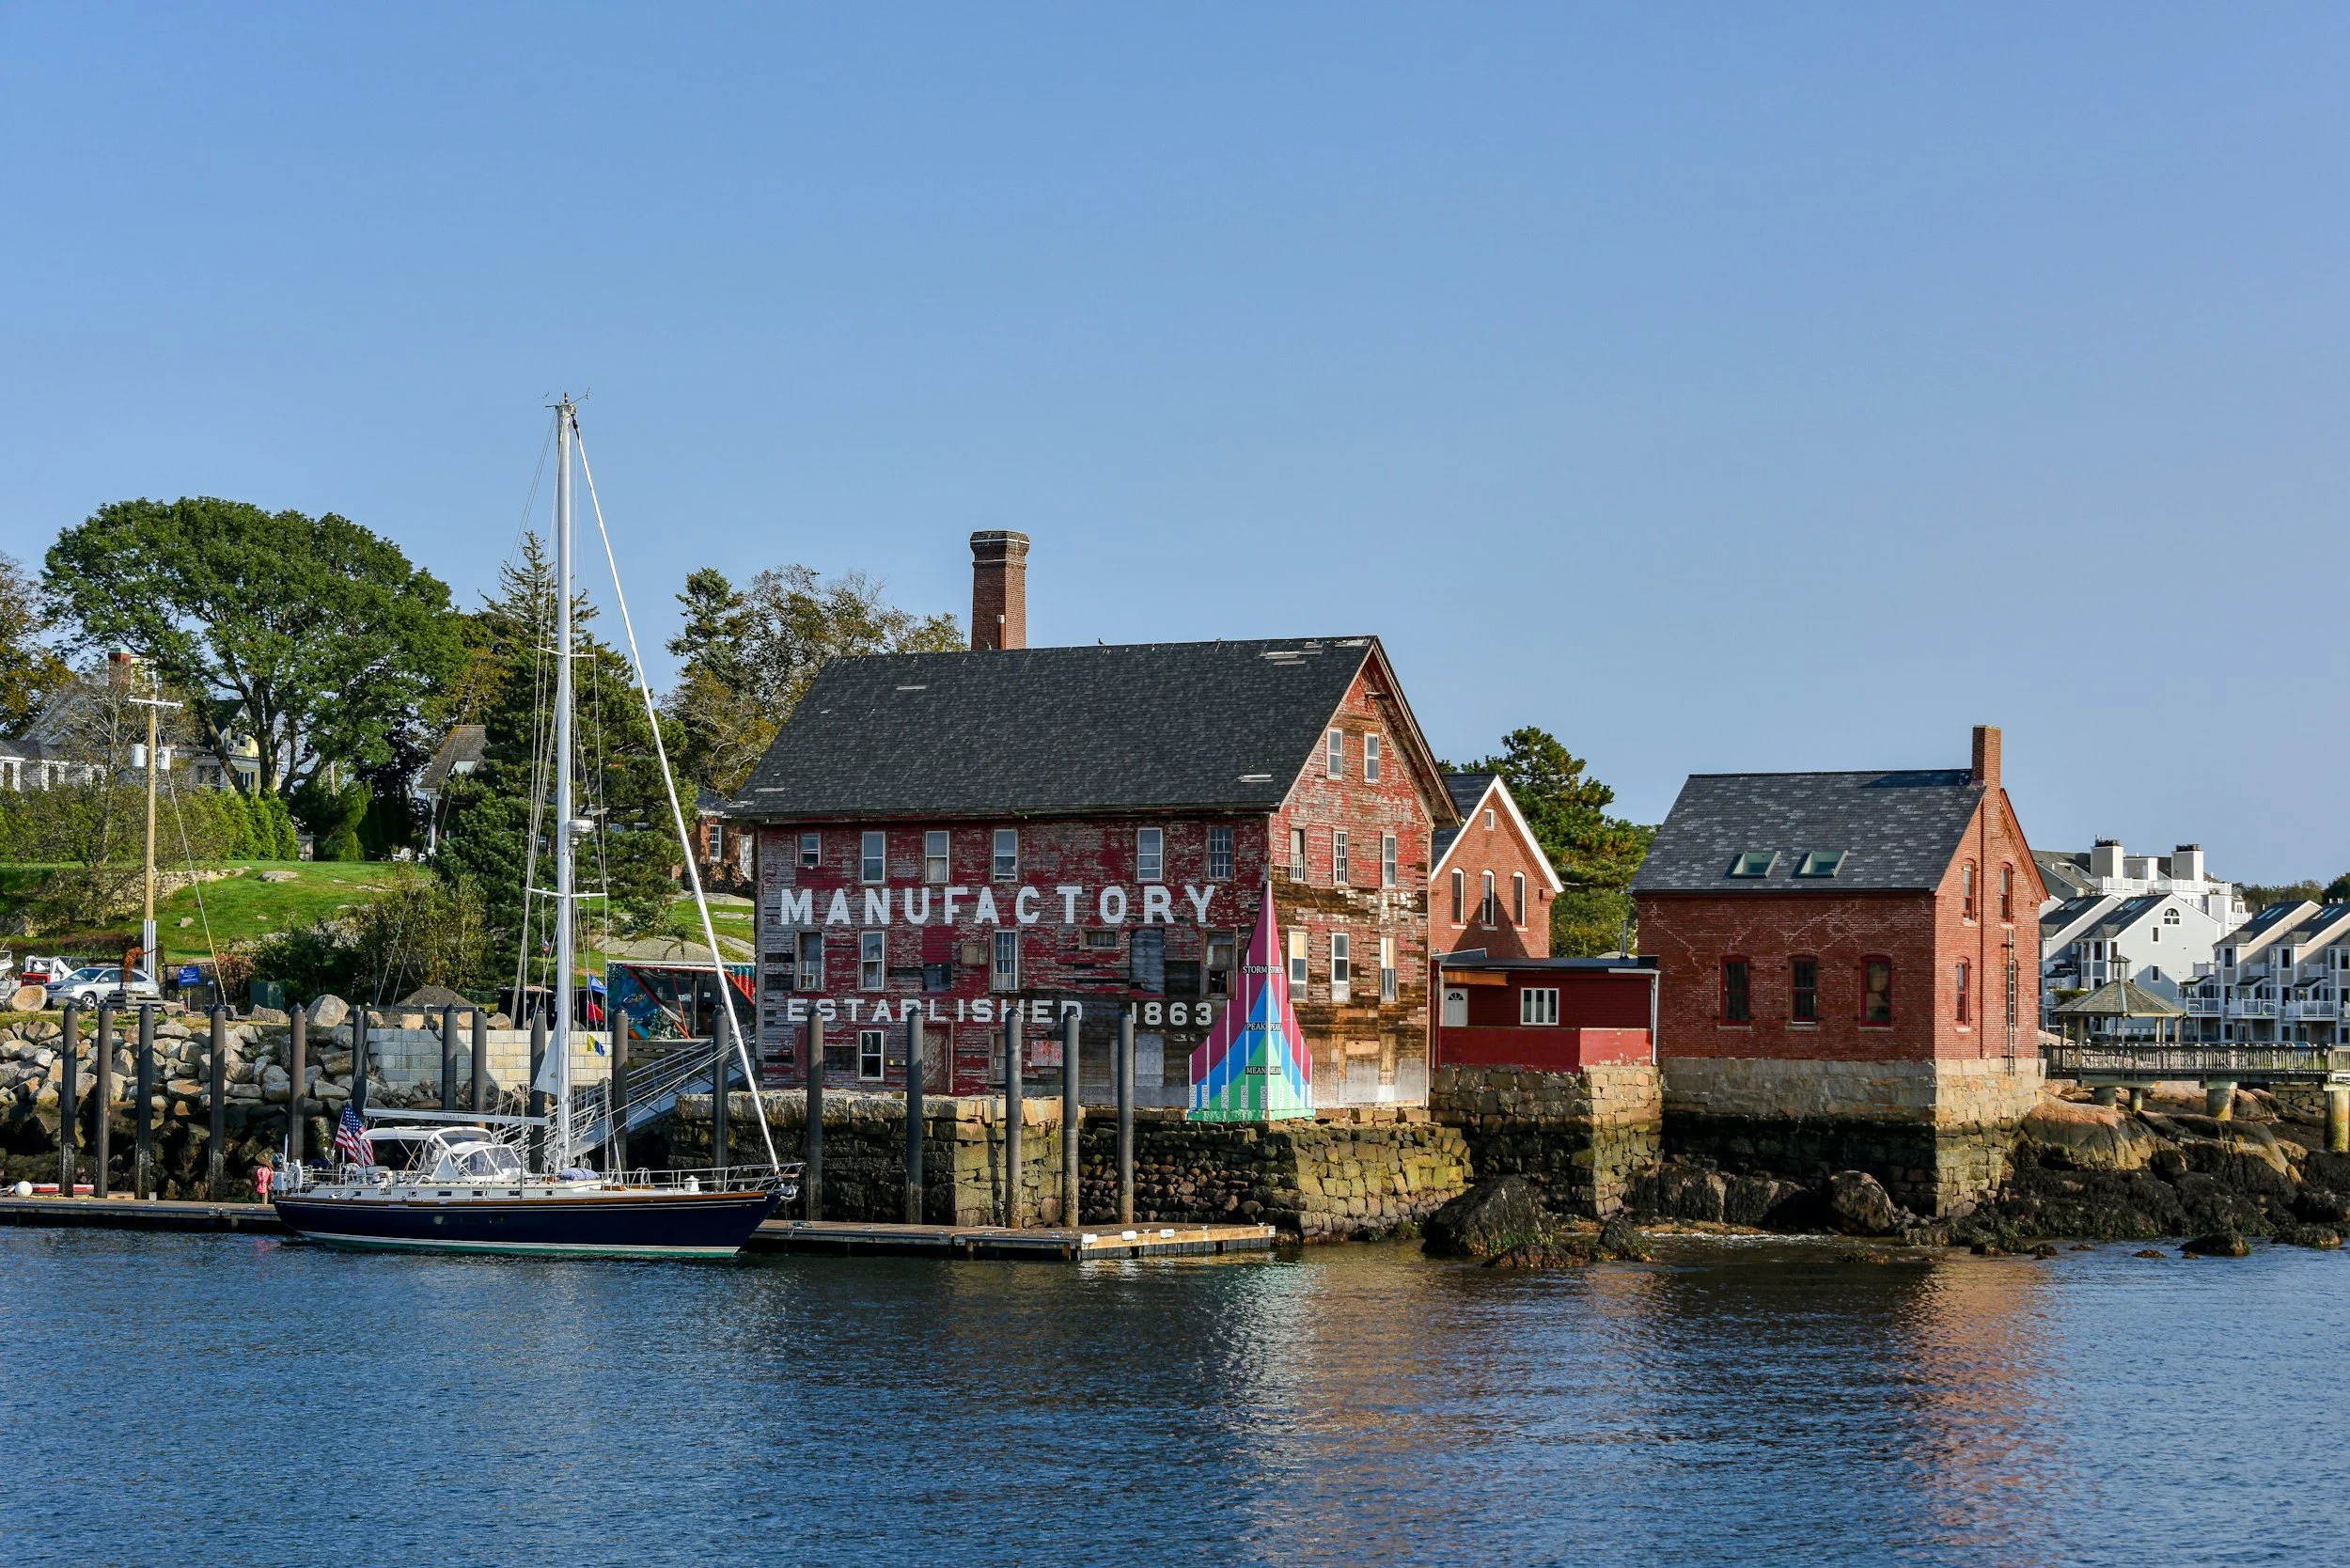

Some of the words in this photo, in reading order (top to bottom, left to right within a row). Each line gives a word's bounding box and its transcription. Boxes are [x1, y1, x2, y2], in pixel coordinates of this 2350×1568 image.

[781, 886, 1215, 925] MANUFACTORY
[1243, 965, 1267, 974] STORM
[1131, 1001, 1213, 1026] 1863
